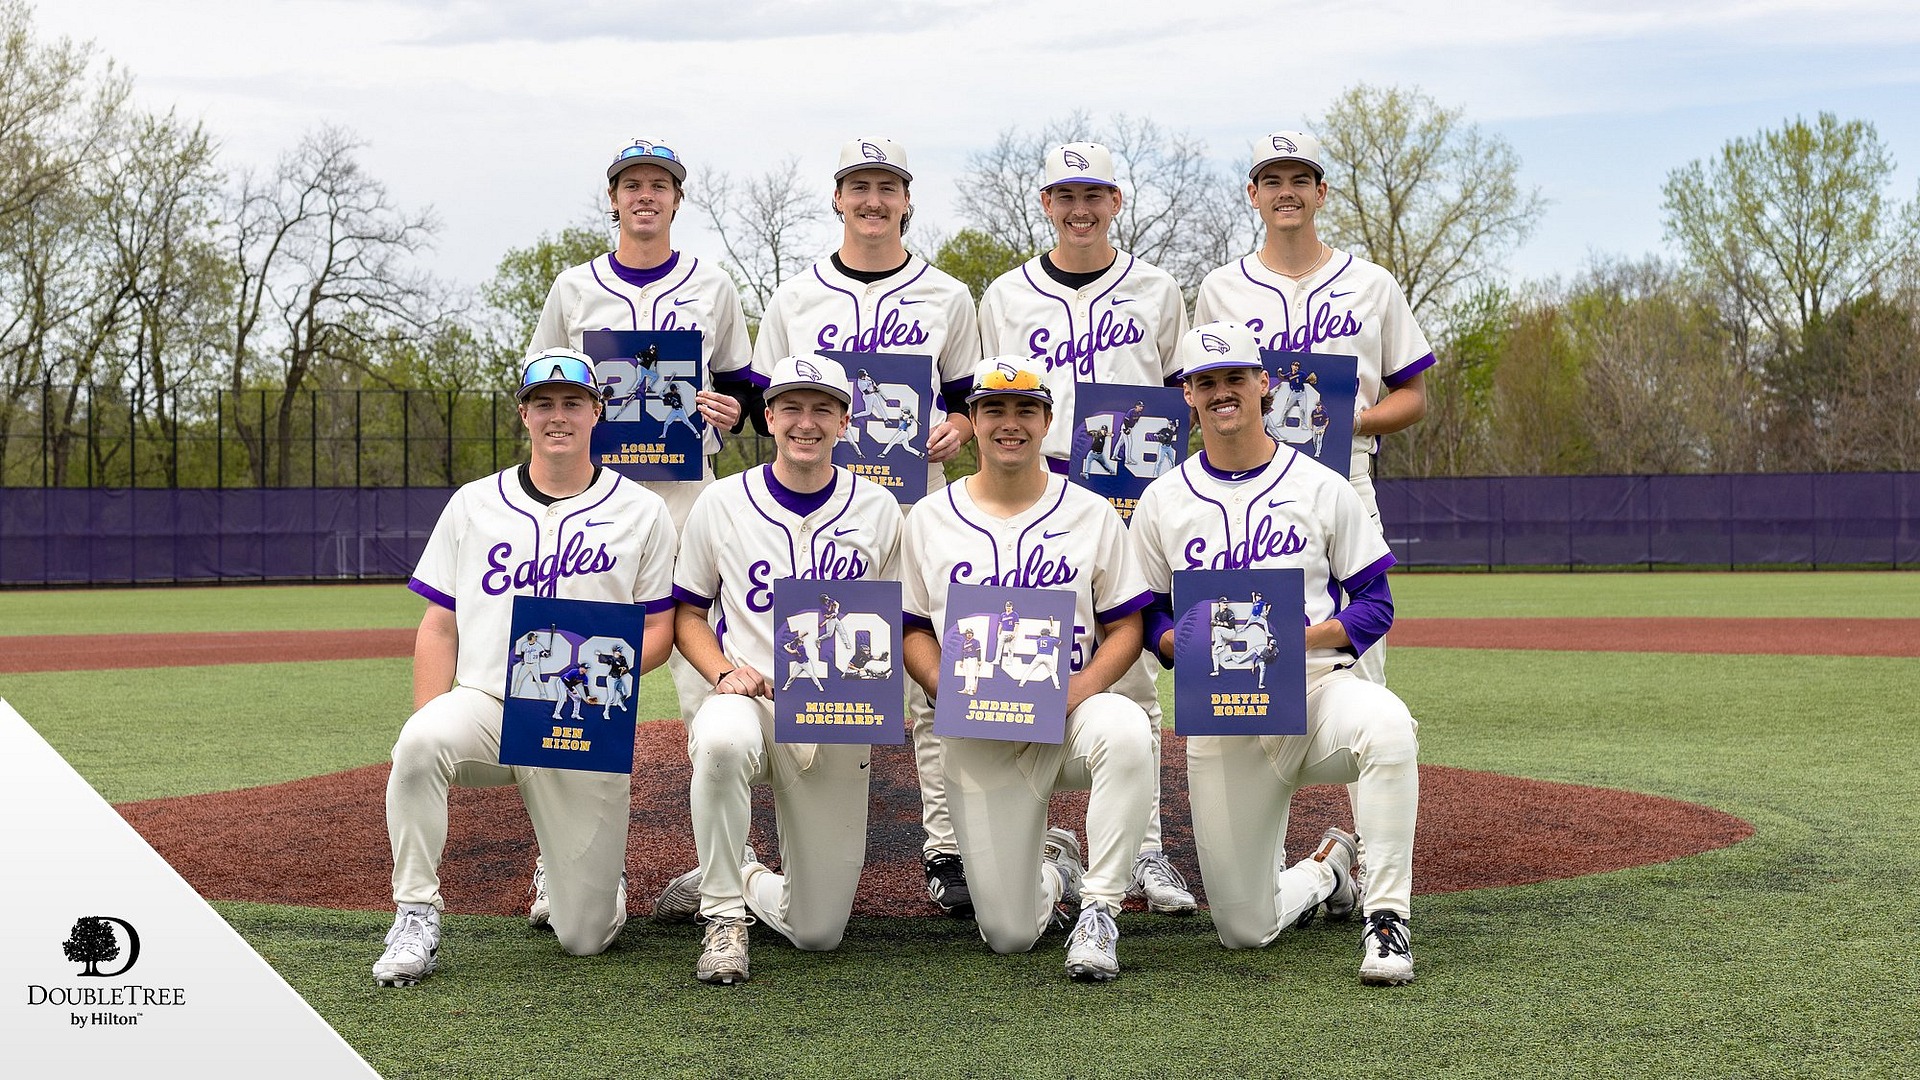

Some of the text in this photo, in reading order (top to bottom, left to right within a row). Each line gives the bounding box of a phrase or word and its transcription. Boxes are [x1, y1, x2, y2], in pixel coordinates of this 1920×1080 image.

[594, 360, 698, 422] 25
[621, 443, 665, 453] LOGAN
[1082, 414, 1178, 478] 16
[601, 454, 685, 464] KARNOWSKI
[481, 531, 618, 598] Eagles
[745, 541, 869, 613] Eles
[786, 610, 892, 679] 10
[953, 615, 1061, 682] 15
[510, 630, 636, 706] 28
[1211, 693, 1270, 705] DREYER
[806, 702, 874, 713] MICHAEL
[968, 700, 1035, 714] ANDREW
[1213, 705, 1267, 716] HOMAN
[795, 713, 884, 725] BORCHARDT
[965, 710, 1036, 725] JOHNSON
[552, 726, 583, 739] BEN
[542, 737, 591, 751] HIXON
